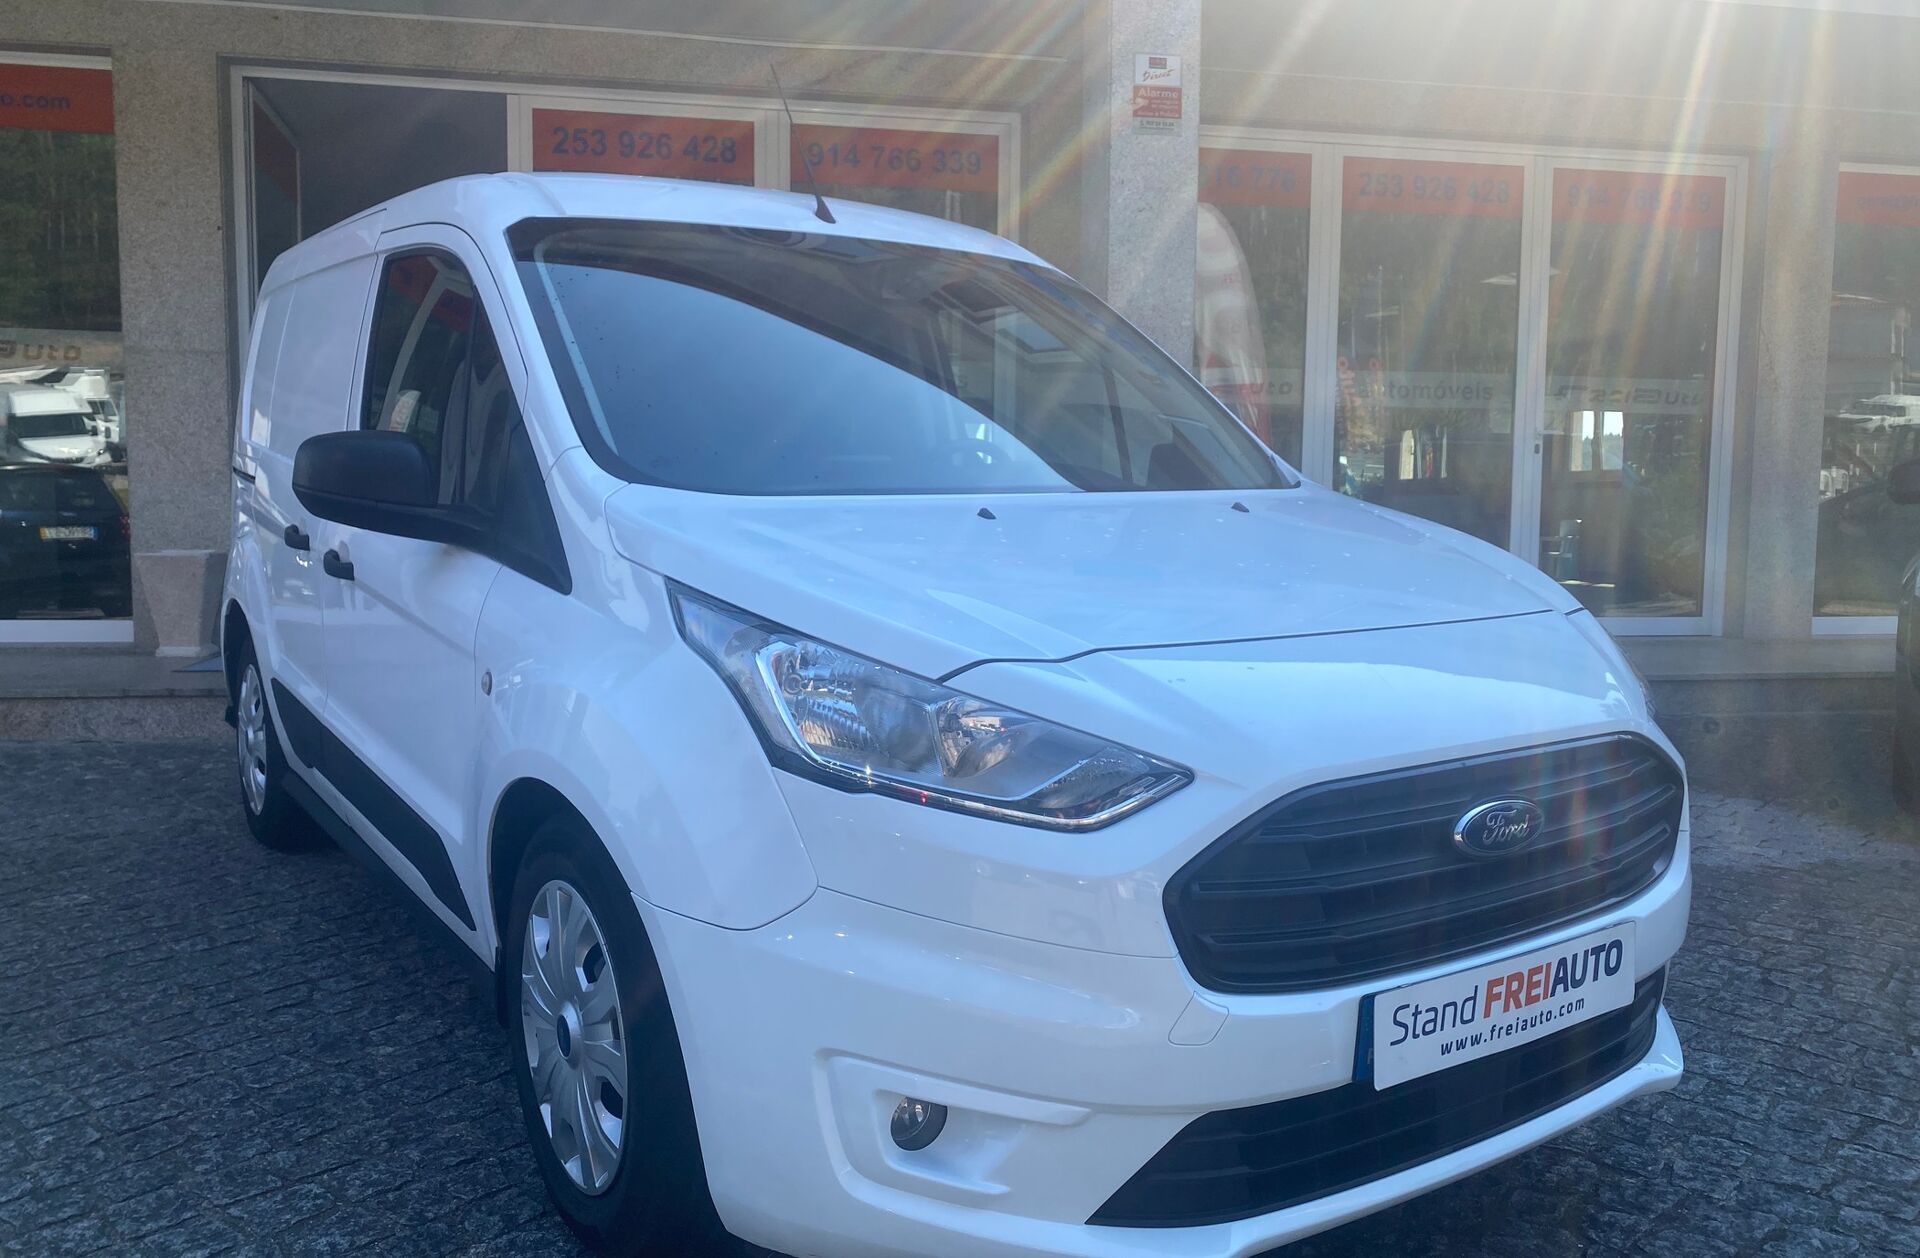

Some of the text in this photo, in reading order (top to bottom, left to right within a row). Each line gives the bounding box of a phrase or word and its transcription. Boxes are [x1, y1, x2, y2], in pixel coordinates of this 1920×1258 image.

[552, 126, 737, 164] 253 926 428
[806, 141, 982, 176] 914 766 339
[1358, 171, 1404, 199] 253
[1483, 808, 1531, 845] Ford
[1389, 938, 1623, 1047] Stand FREIAUTO
[1440, 997, 1585, 1056] www.freiauto.com
